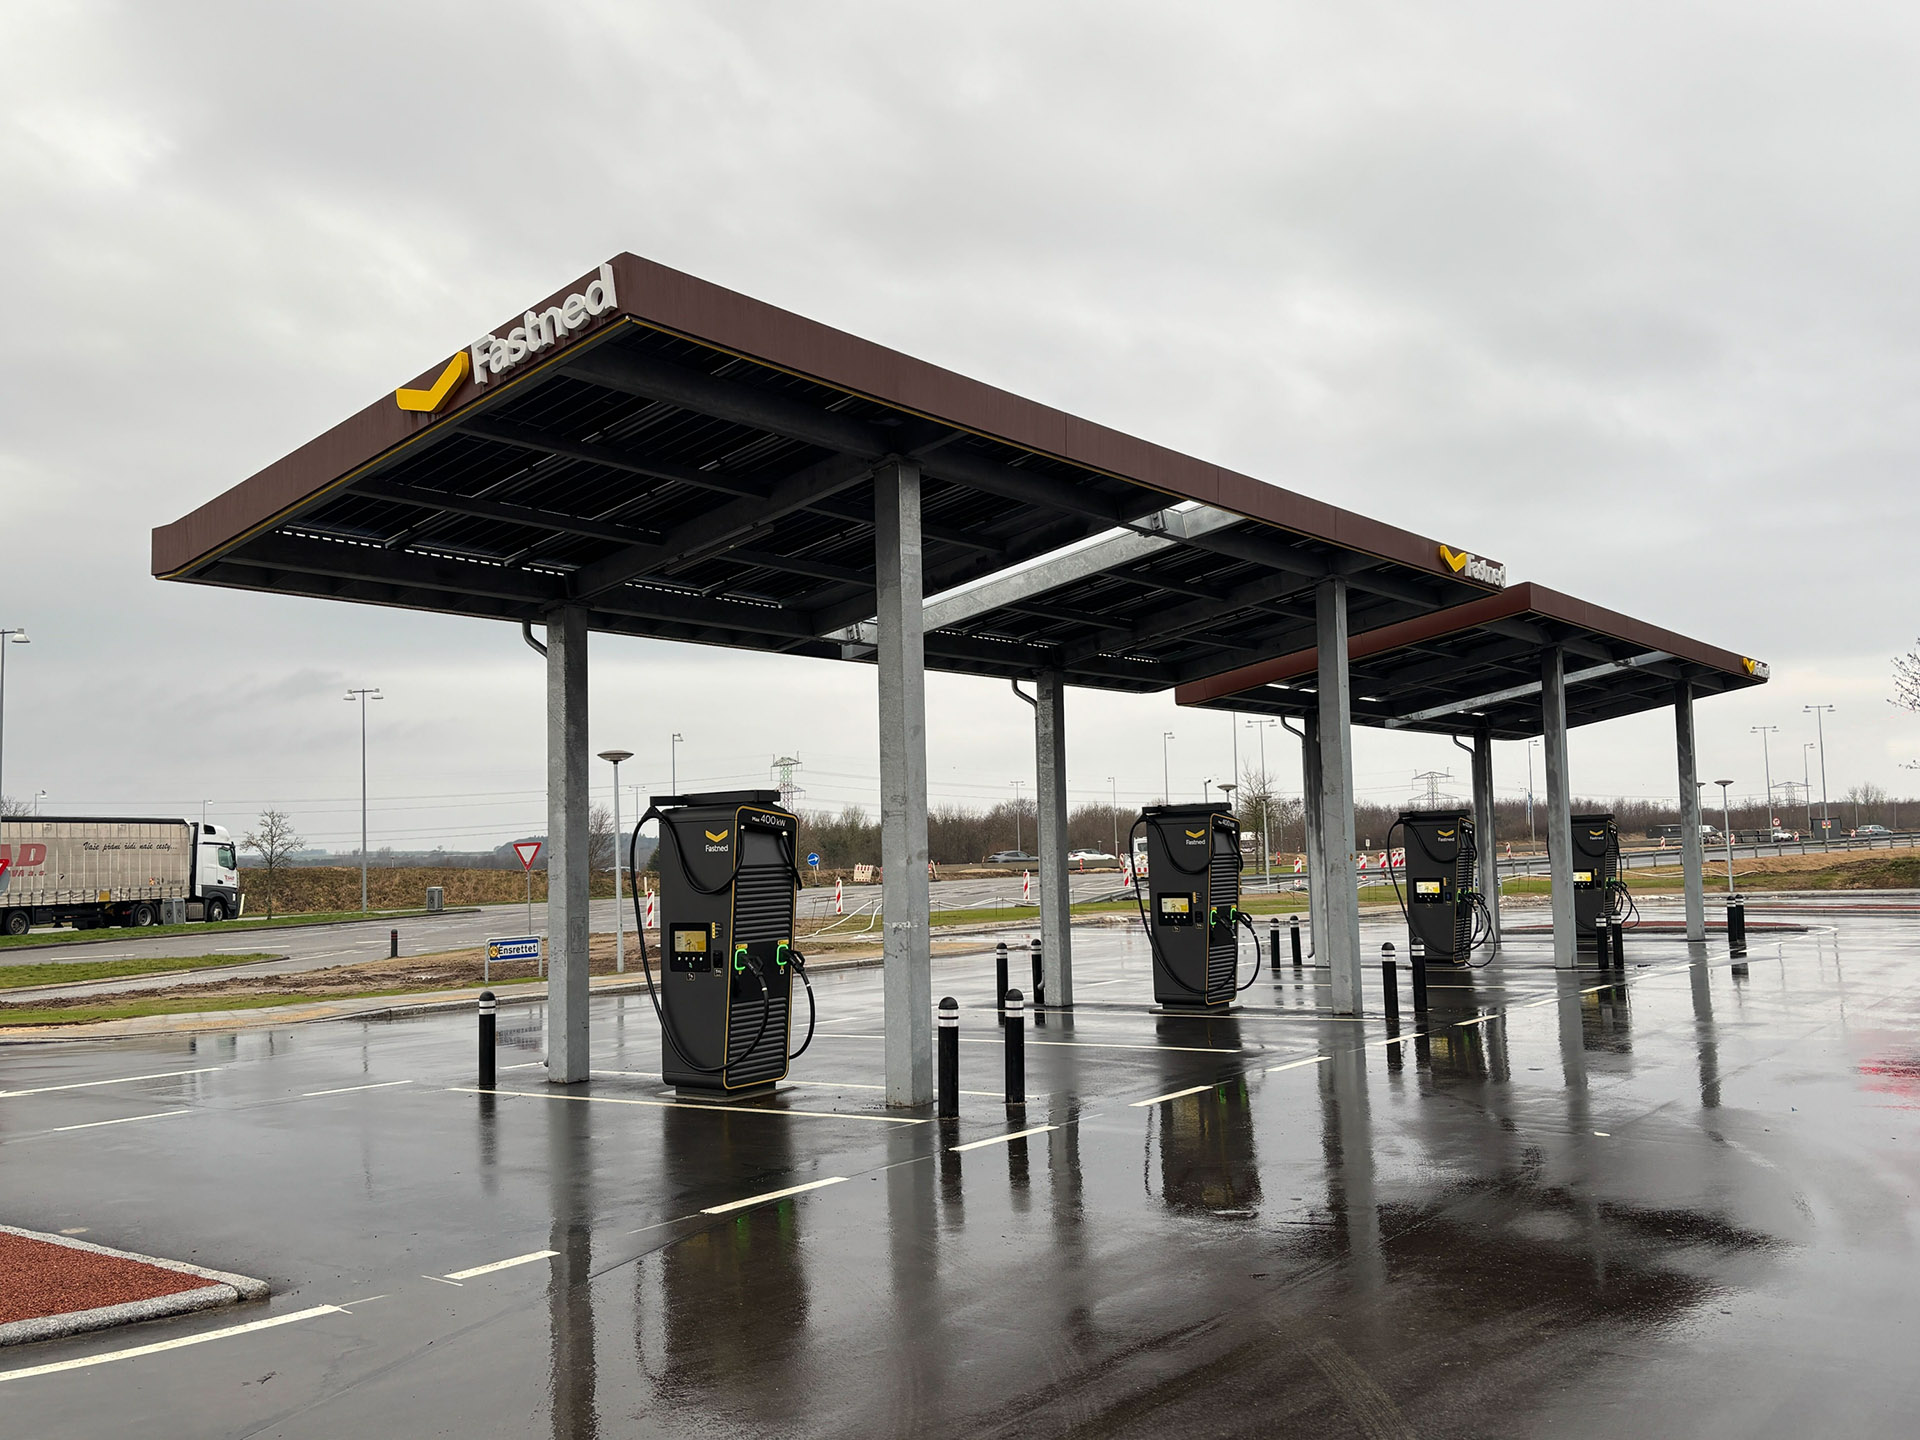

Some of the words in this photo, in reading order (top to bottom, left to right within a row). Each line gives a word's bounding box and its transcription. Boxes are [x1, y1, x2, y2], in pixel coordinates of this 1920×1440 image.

[471, 262, 618, 385] Fastned
[1465, 554, 1506, 588] Fastned
[760, 814, 776, 825] 400
[705, 844, 729, 852] Fastned
[498, 944, 537, 955] Ensrettet
